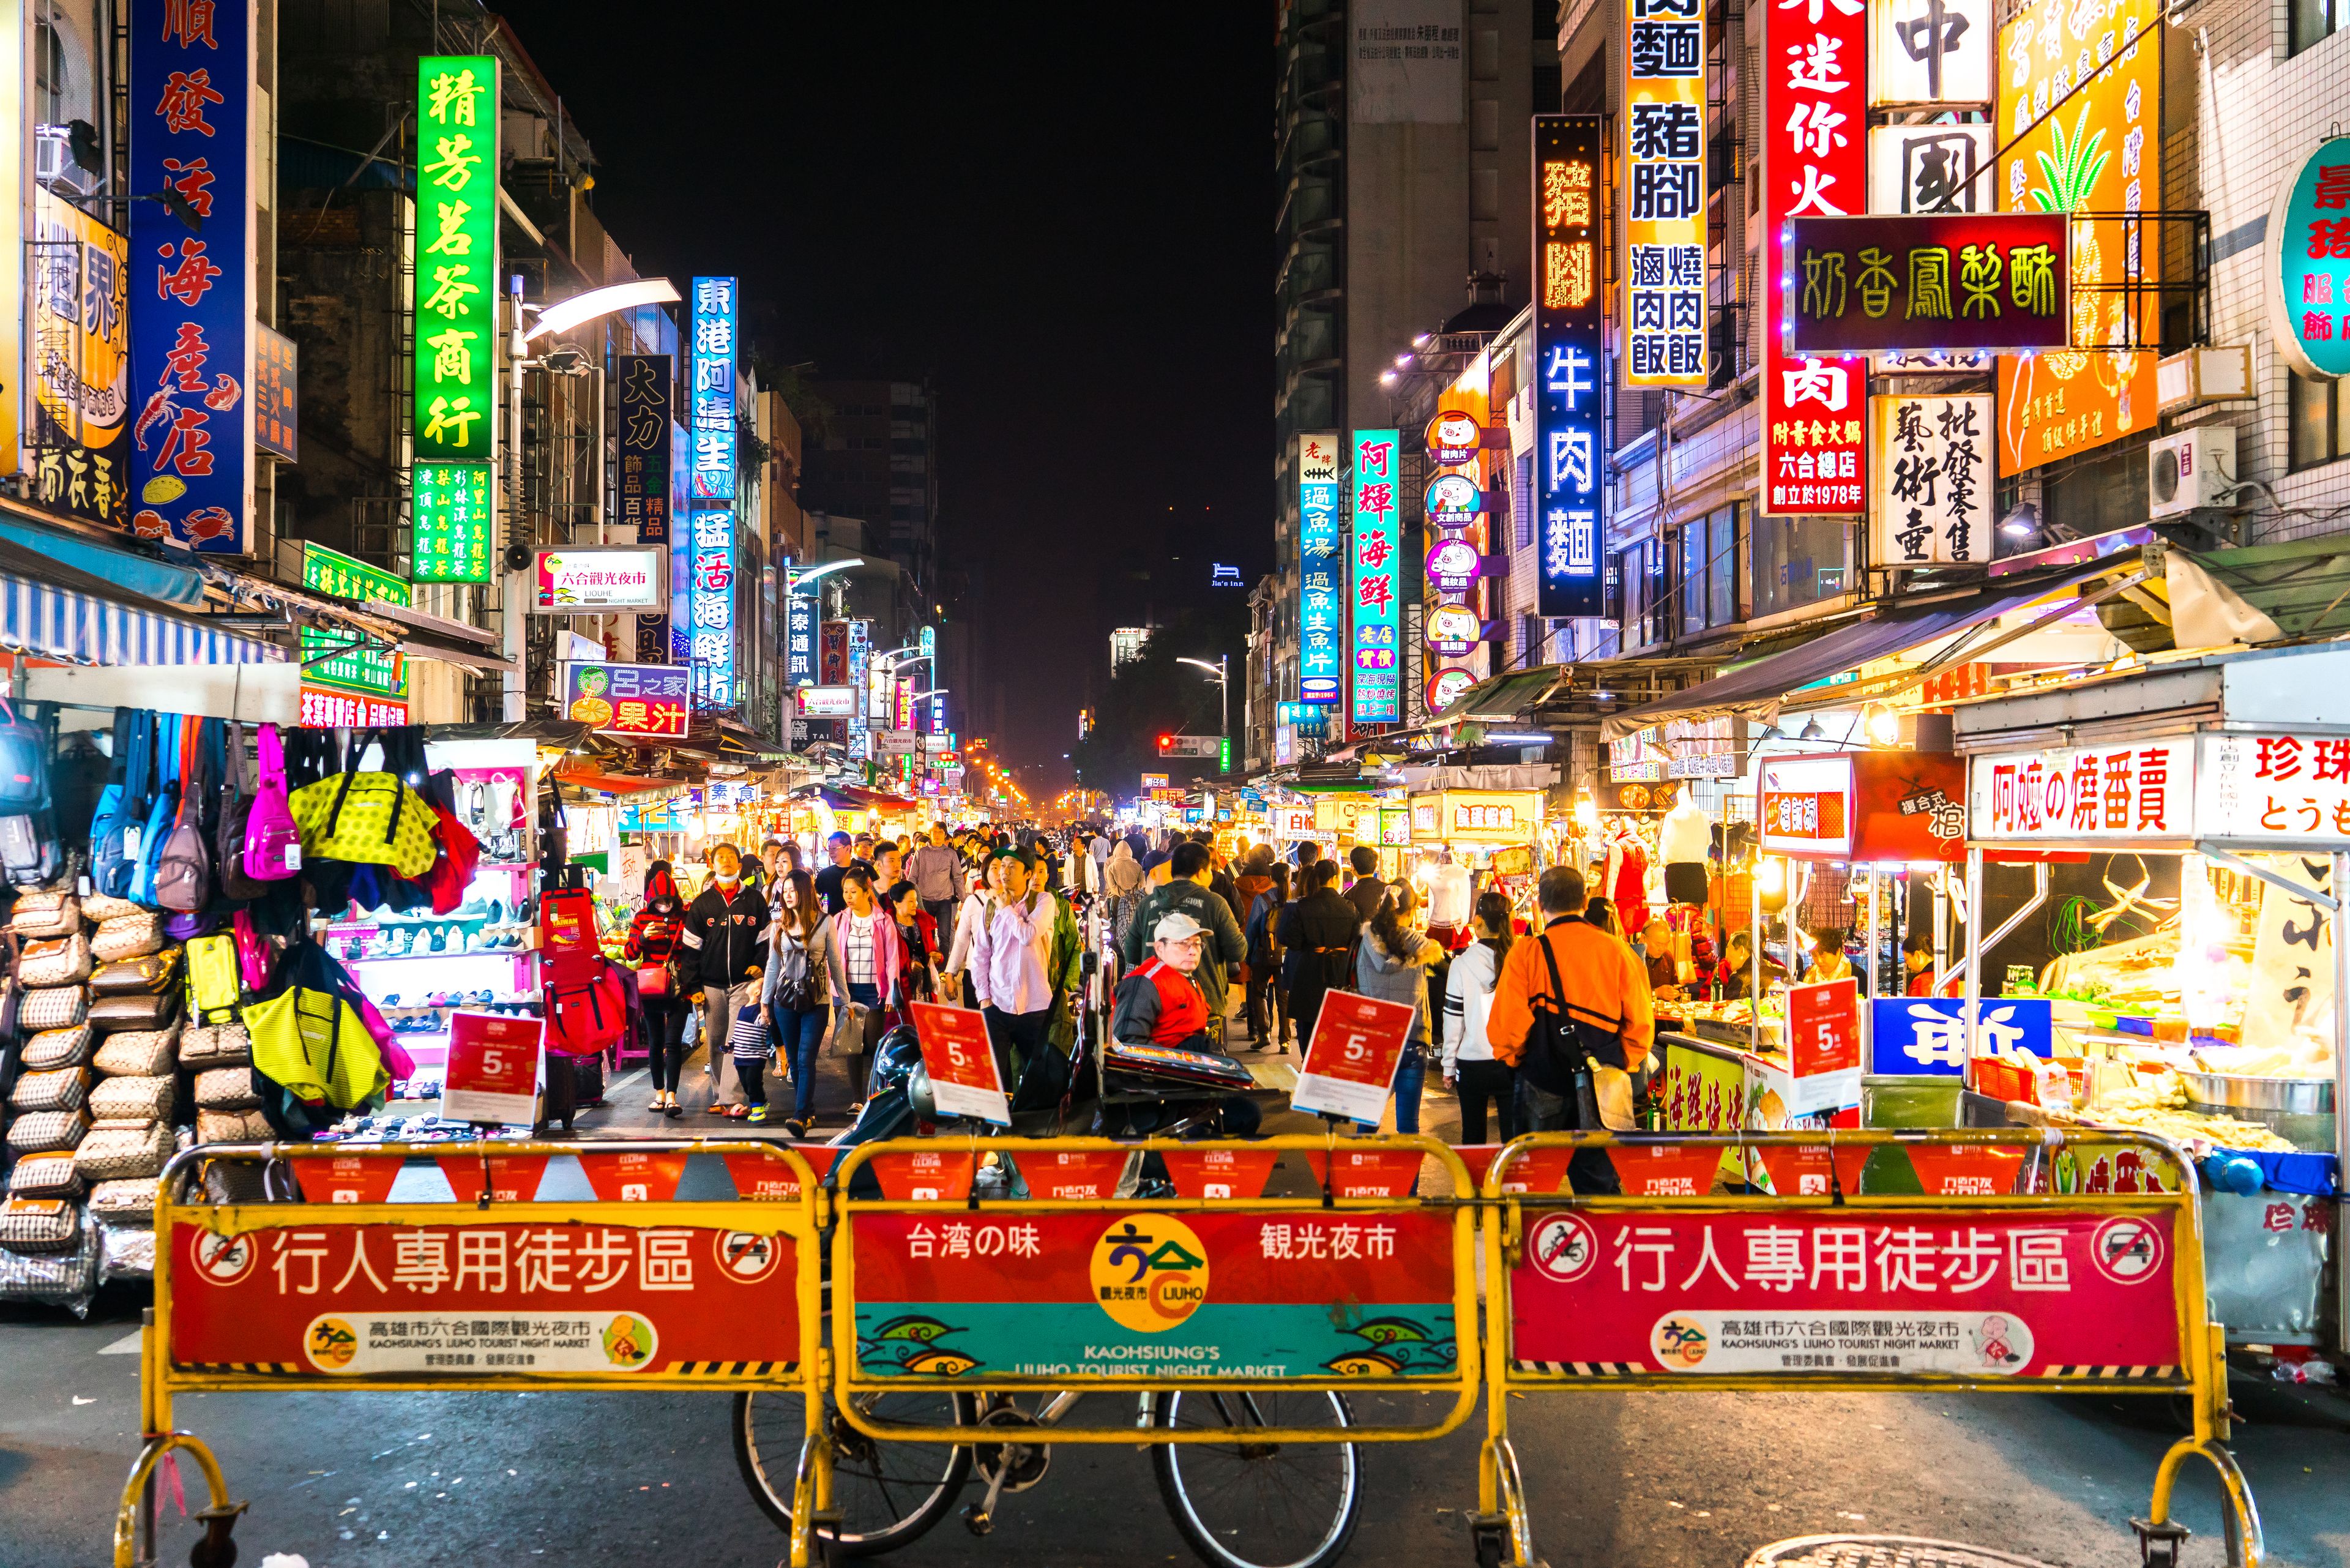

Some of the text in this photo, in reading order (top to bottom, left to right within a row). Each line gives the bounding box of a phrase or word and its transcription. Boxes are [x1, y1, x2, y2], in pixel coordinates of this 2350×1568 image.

[423, 68, 485, 448] 精芳茗茶商行
[624, 359, 665, 450] 大力
[1772, 419, 1862, 447] 附素食火鍋
[1546, 346, 1595, 575] 牛肉麵
[1778, 450, 1856, 479] 六合總店
[1772, 484, 1862, 506] 創立於1978年
[434, 469, 452, 577] 梨山烏龍茶
[470, 470, 487, 577] 阿里山烏龍茶
[1358, 439, 1394, 617] 阿輝海鮮
[561, 572, 646, 586] 六合觀光夜市
[1359, 625, 1393, 644] 老店
[616, 701, 685, 733] 果汁
[1357, 703, 1395, 716] 請上二樓
[271, 1229, 696, 1296] 行人專用徒步區
[1613, 1225, 2072, 1294] 行人專用徒步區
[1163, 1287, 1203, 1301] LIUHO
[369, 1320, 591, 1337] 高雄市六合國際觀光夜市
[1721, 1320, 1960, 1337] 高雄市六合國際觀光夜市
[368, 1337, 590, 1349] KAOHSIUNG'S LIUHO TOURIST NIGHT MARKET
[1084, 1345, 1220, 1360] KAOHSIUNG'S
[1721, 1338, 1960, 1350] KAOHSIUNG'S LIUHO TOURIST NIGHT MARKET
[1217, 1365, 1286, 1378] MARKET
